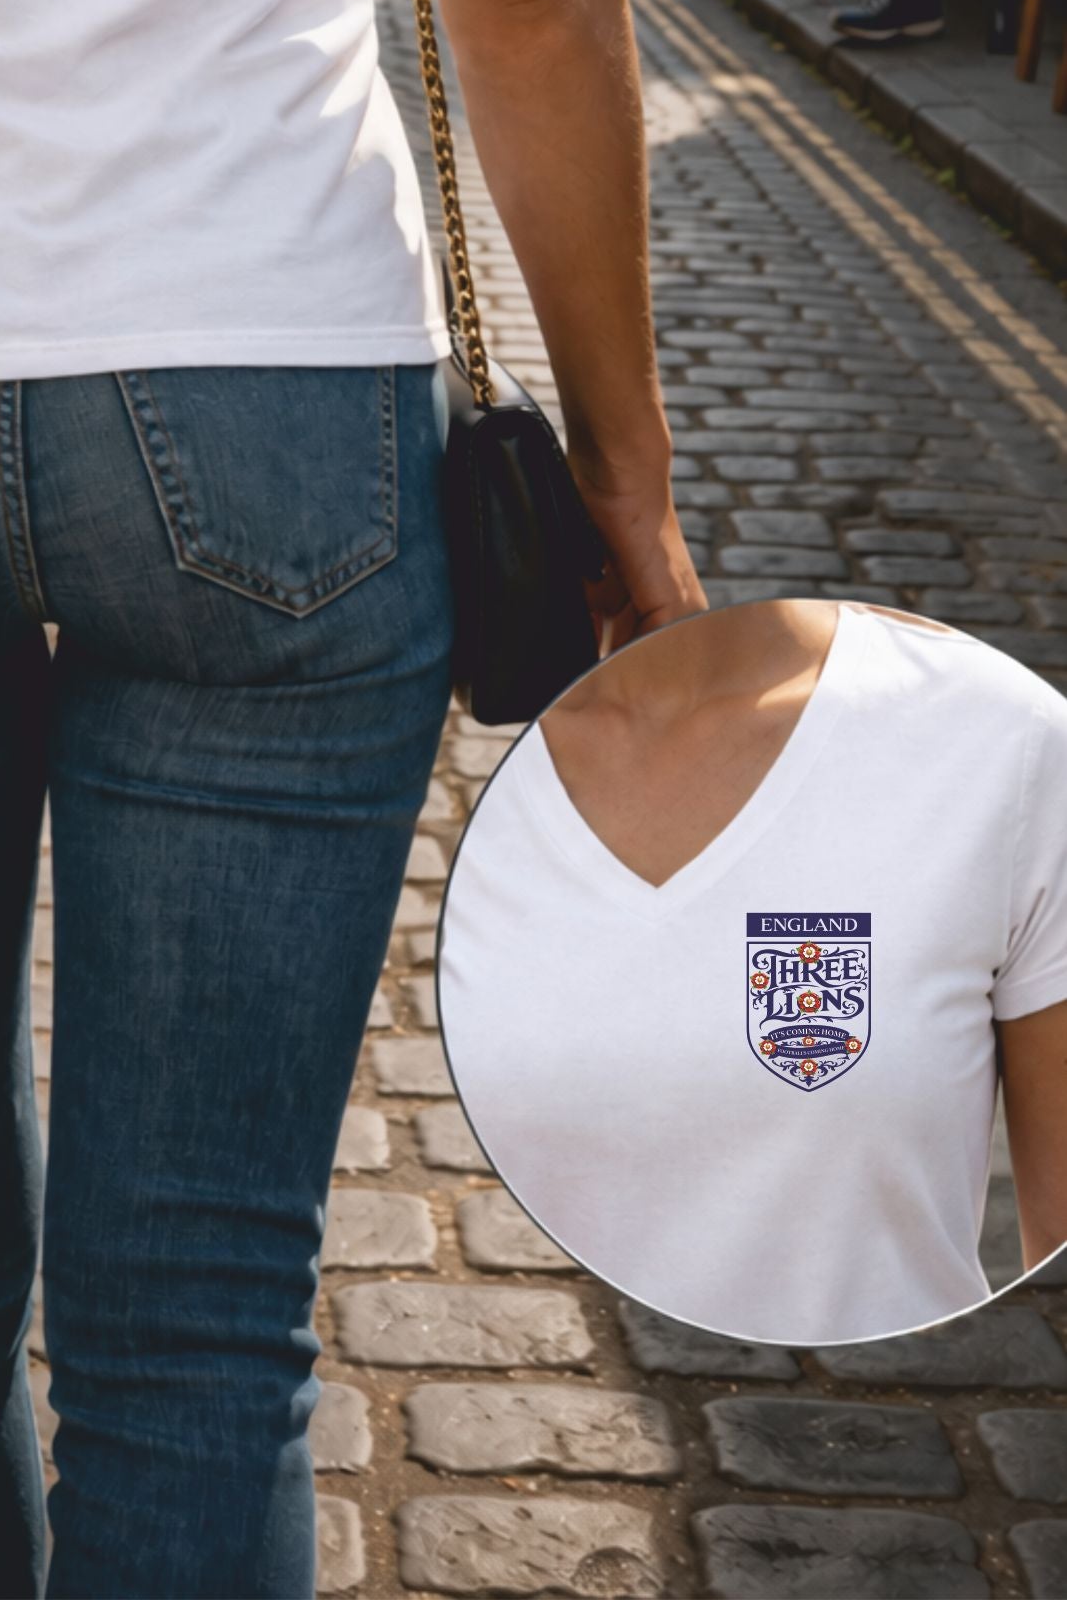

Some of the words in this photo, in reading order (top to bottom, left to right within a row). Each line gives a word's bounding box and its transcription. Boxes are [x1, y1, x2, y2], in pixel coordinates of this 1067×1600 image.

[761, 918, 858, 932] ENGLAND
[752, 949, 865, 988] THREE
[760, 986, 865, 1025] LINS
[786, 1028, 820, 1036] COMING
[821, 1028, 847, 1040] HOME
